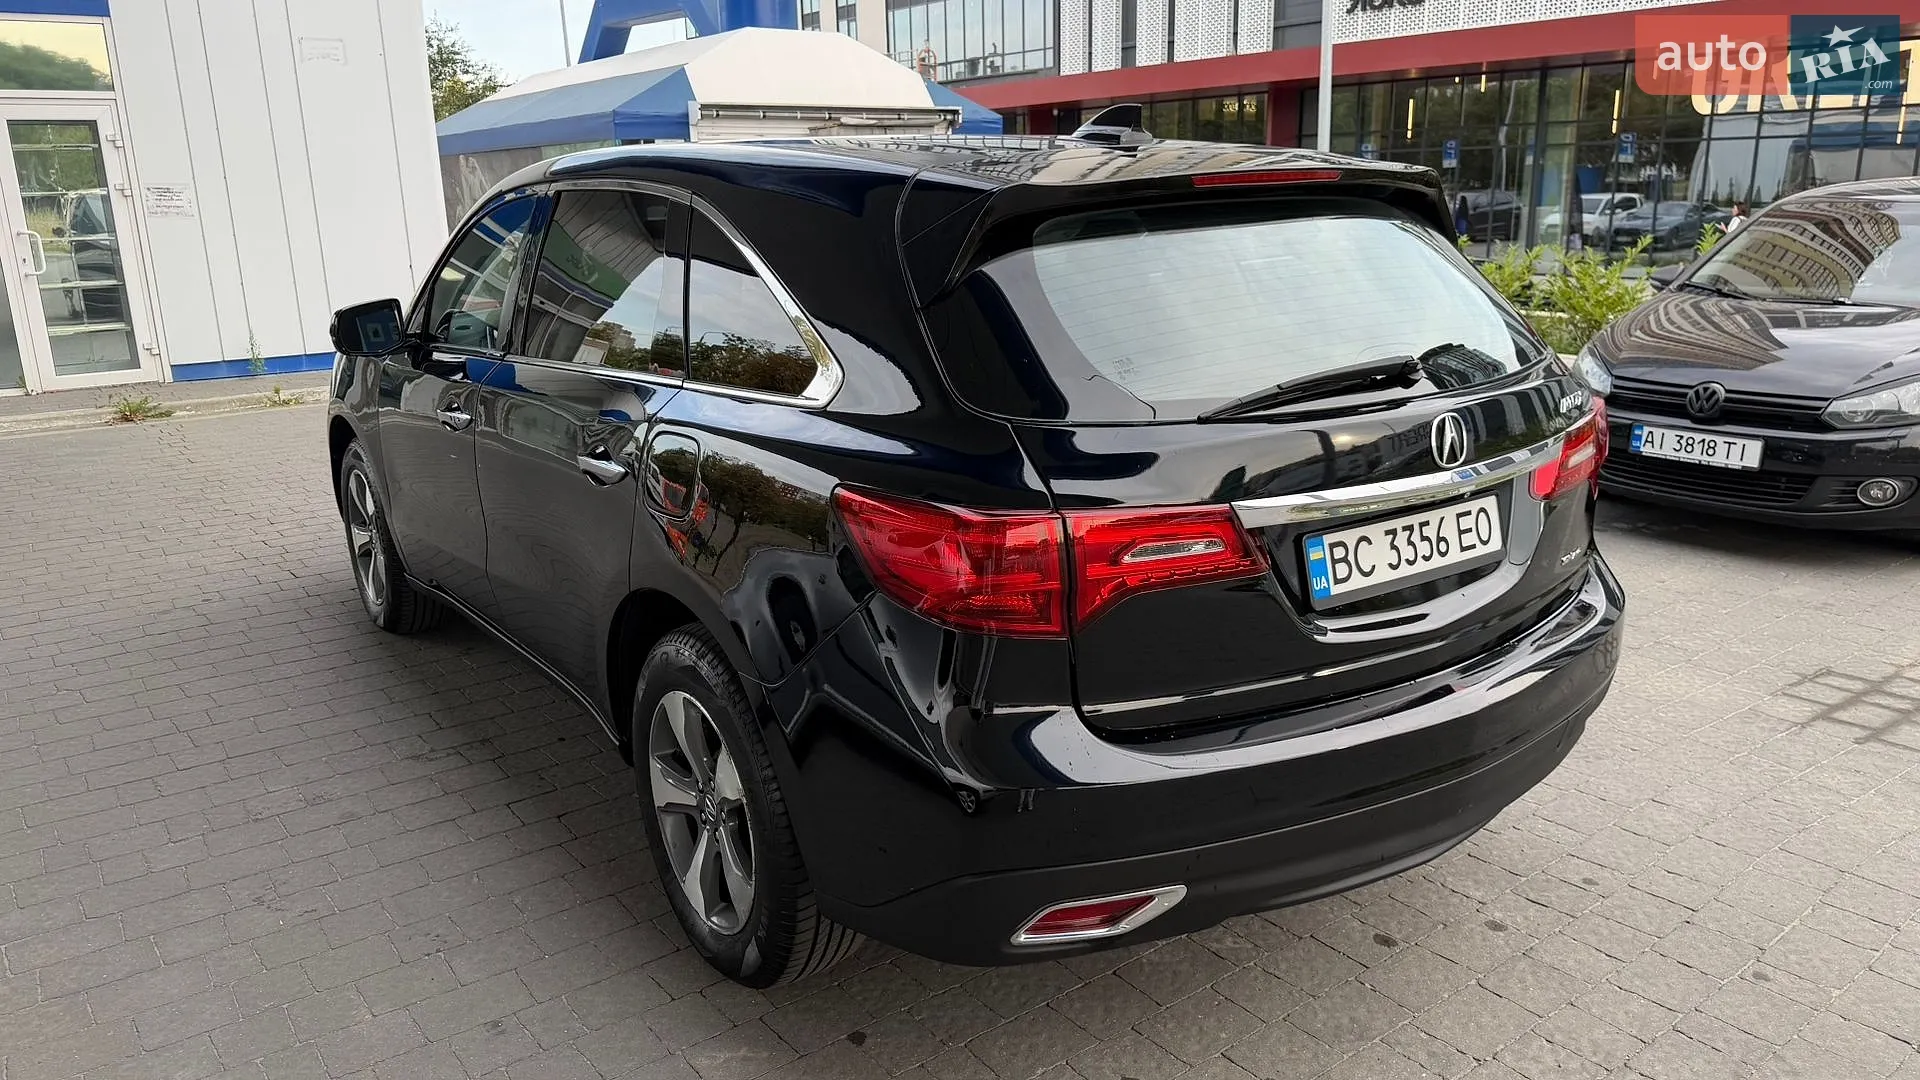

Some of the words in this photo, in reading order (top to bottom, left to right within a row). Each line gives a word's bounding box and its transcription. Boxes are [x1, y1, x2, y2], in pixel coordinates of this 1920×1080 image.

[1643, 430, 1665, 449] AI
[1673, 434, 1717, 457] 3818
[1723, 441, 1746, 461] TI
[1328, 535, 1376, 586] BC
[1384, 516, 1450, 571] 3356
[1455, 506, 1492, 553] EO
[1313, 576, 1328, 591] UA
